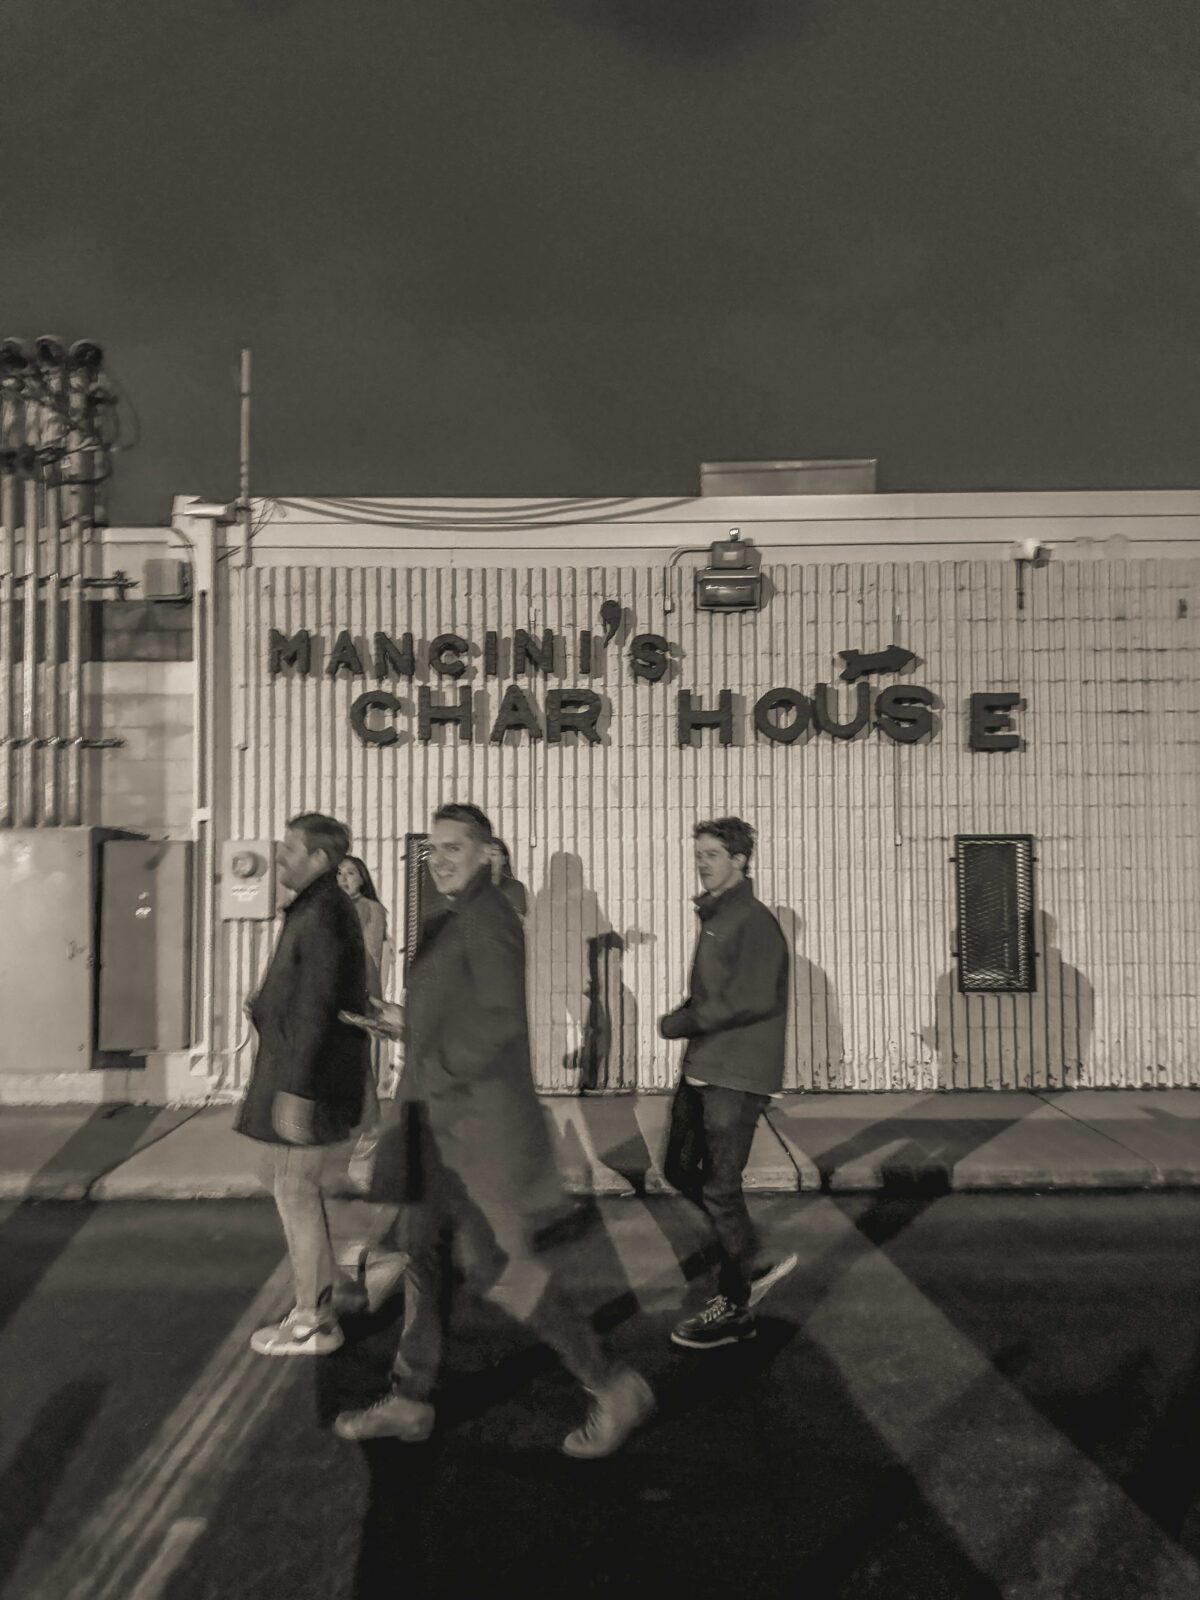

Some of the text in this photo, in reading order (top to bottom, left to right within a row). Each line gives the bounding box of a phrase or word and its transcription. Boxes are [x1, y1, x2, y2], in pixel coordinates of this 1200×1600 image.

[269, 600, 669, 683] MANCINI'S
[350, 682, 1022, 752] CHAR HOUSE
